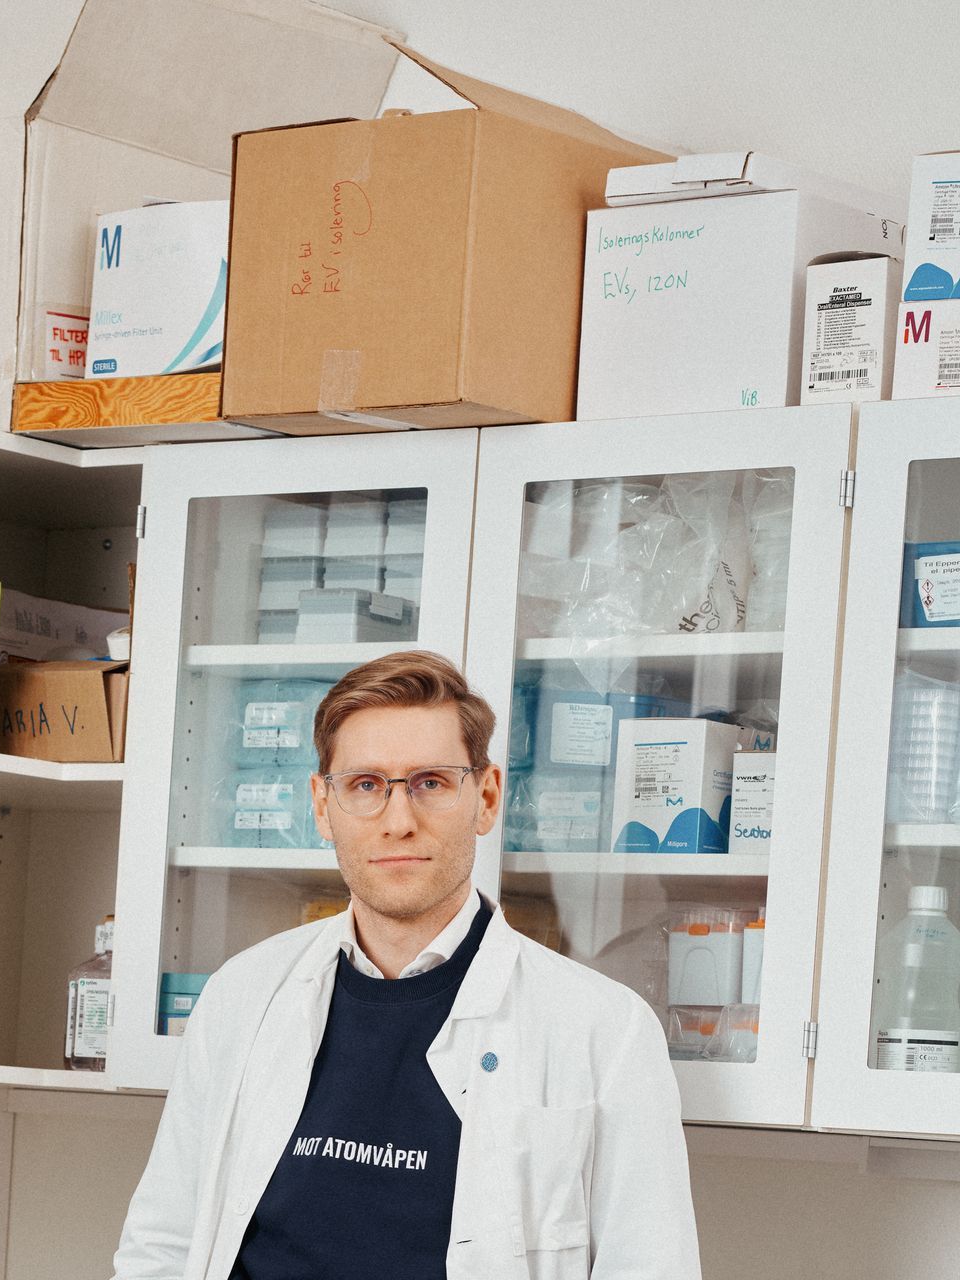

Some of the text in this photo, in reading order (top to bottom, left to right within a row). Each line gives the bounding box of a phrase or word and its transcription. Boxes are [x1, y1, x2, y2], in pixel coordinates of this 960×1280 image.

[93, 361, 115, 371] STERILE
[667, 840, 688, 848] Millipore
[292, 1136, 428, 1170] MOT ATOMVÅPEN
